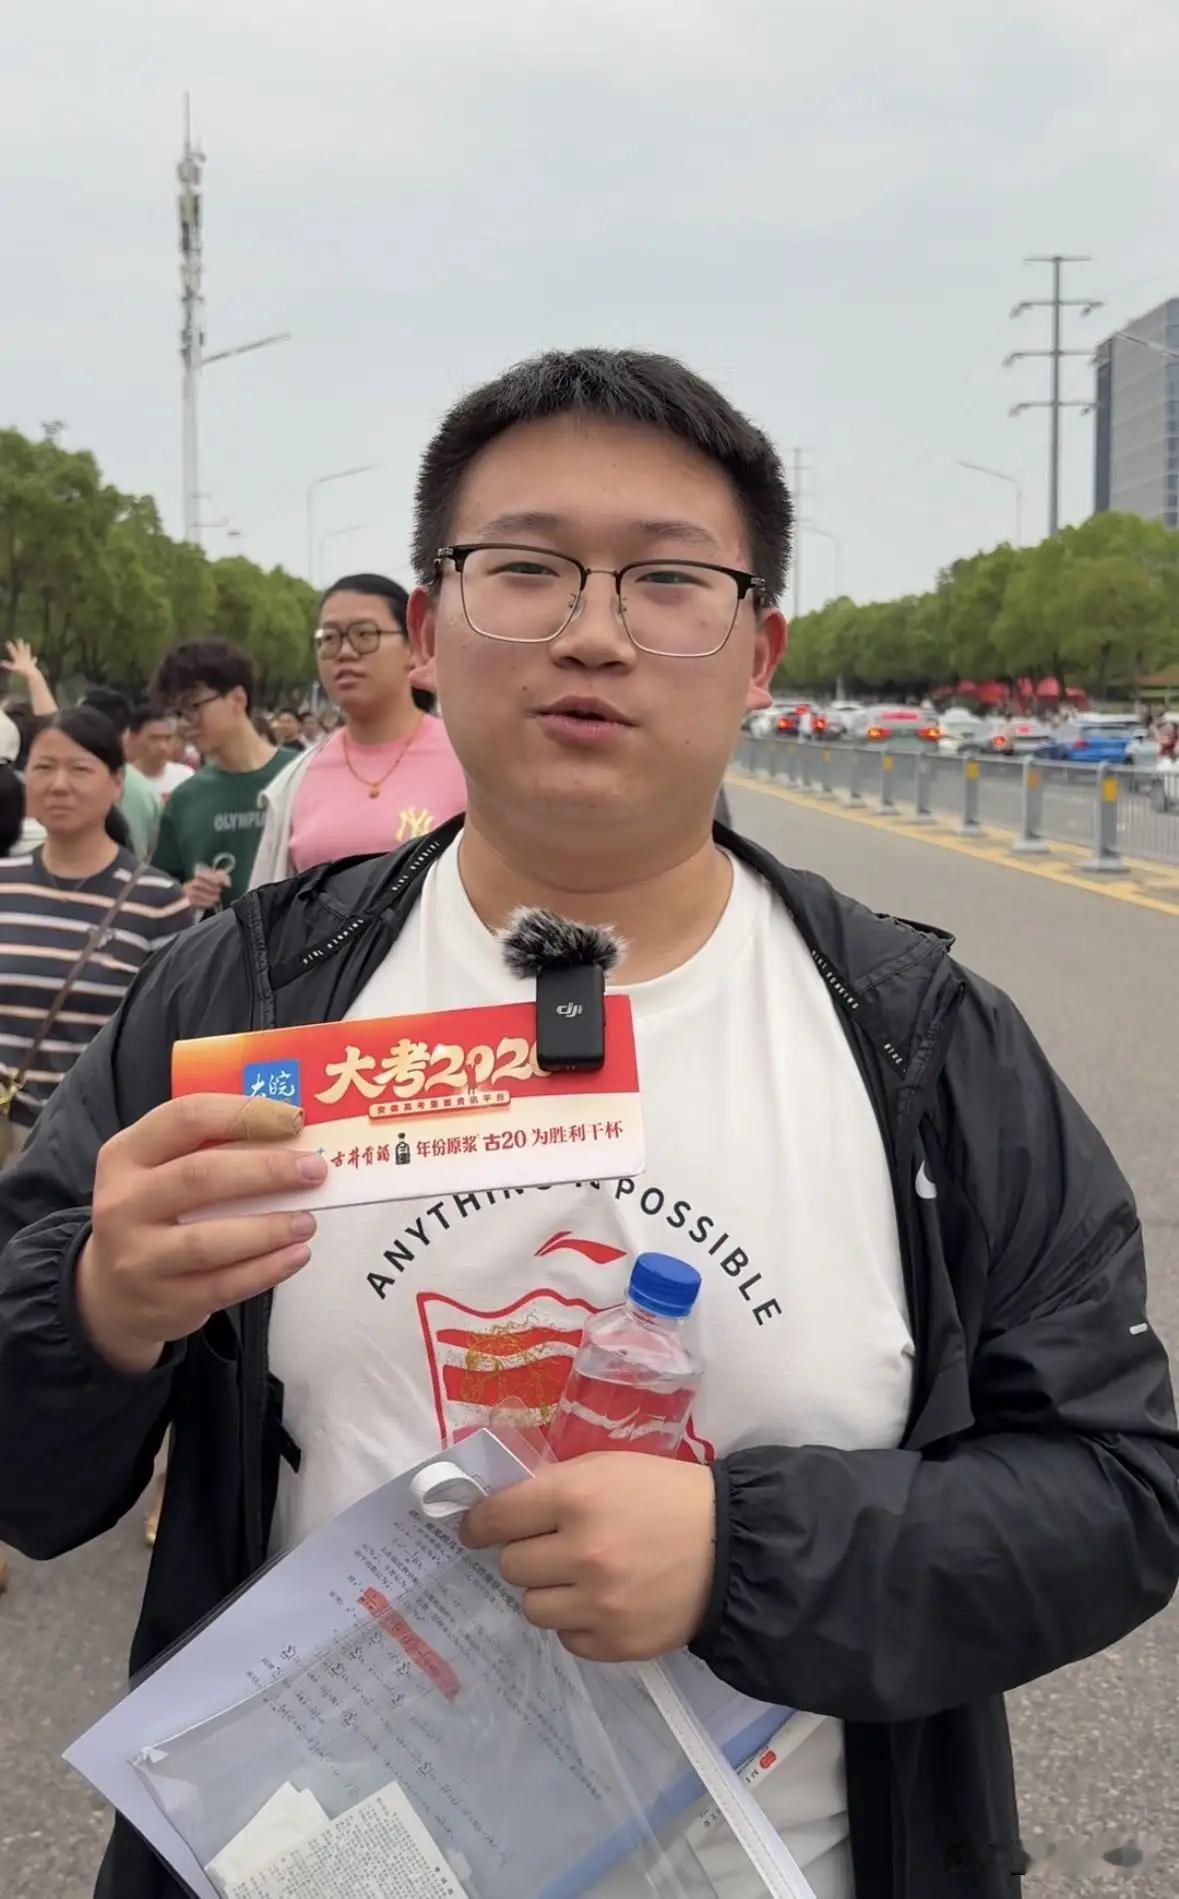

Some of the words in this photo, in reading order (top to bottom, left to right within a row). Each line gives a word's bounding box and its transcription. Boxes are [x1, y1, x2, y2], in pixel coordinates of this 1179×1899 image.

[250, 1070, 296, 1098] 大皖
[416, 1134, 478, 1159] 年份原浆
[482, 1129, 528, 1152] 古20
[531, 1119, 624, 1147] 为胜利干杯
[365, 1185, 551, 1300] ANYTHI
[613, 1177, 783, 1327] POSSIBLE
